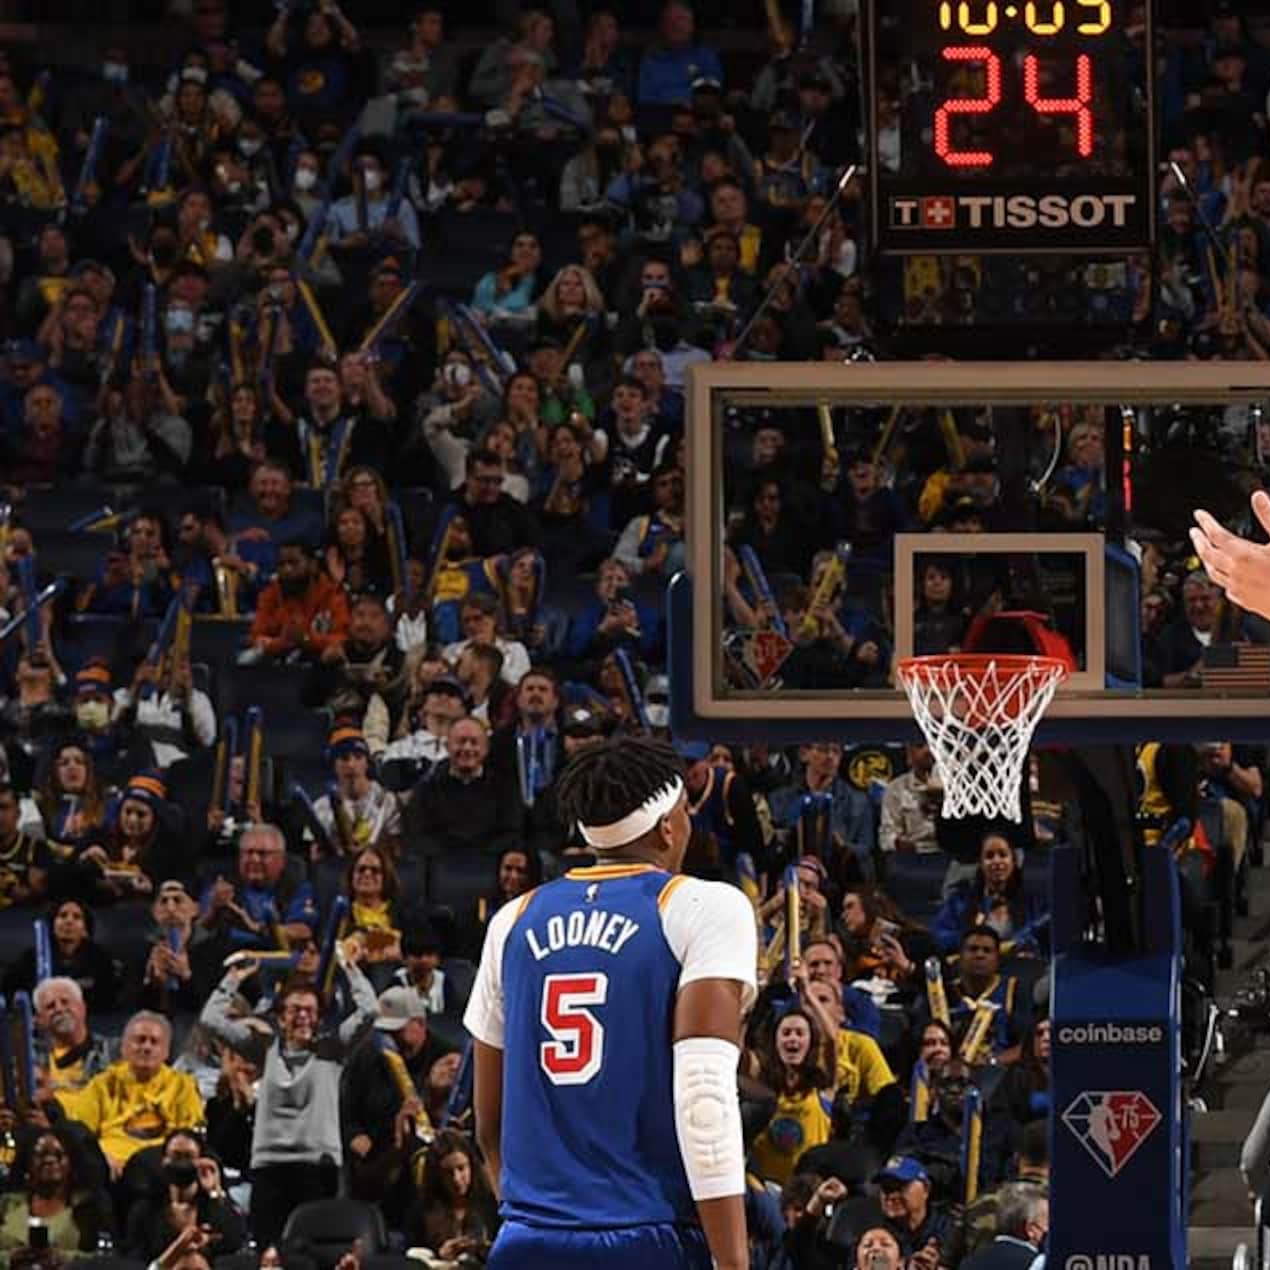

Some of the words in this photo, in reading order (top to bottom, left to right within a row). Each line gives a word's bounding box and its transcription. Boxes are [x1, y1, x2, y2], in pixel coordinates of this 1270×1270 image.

[934, 46, 1093, 166] 24
[959, 195, 1135, 228] TISSOT
[525, 909, 640, 961] LOONEY
[540, 972, 608, 1086] 5
[1058, 1023, 1163, 1044] coinbase
[1119, 1104, 1140, 1129] 75
